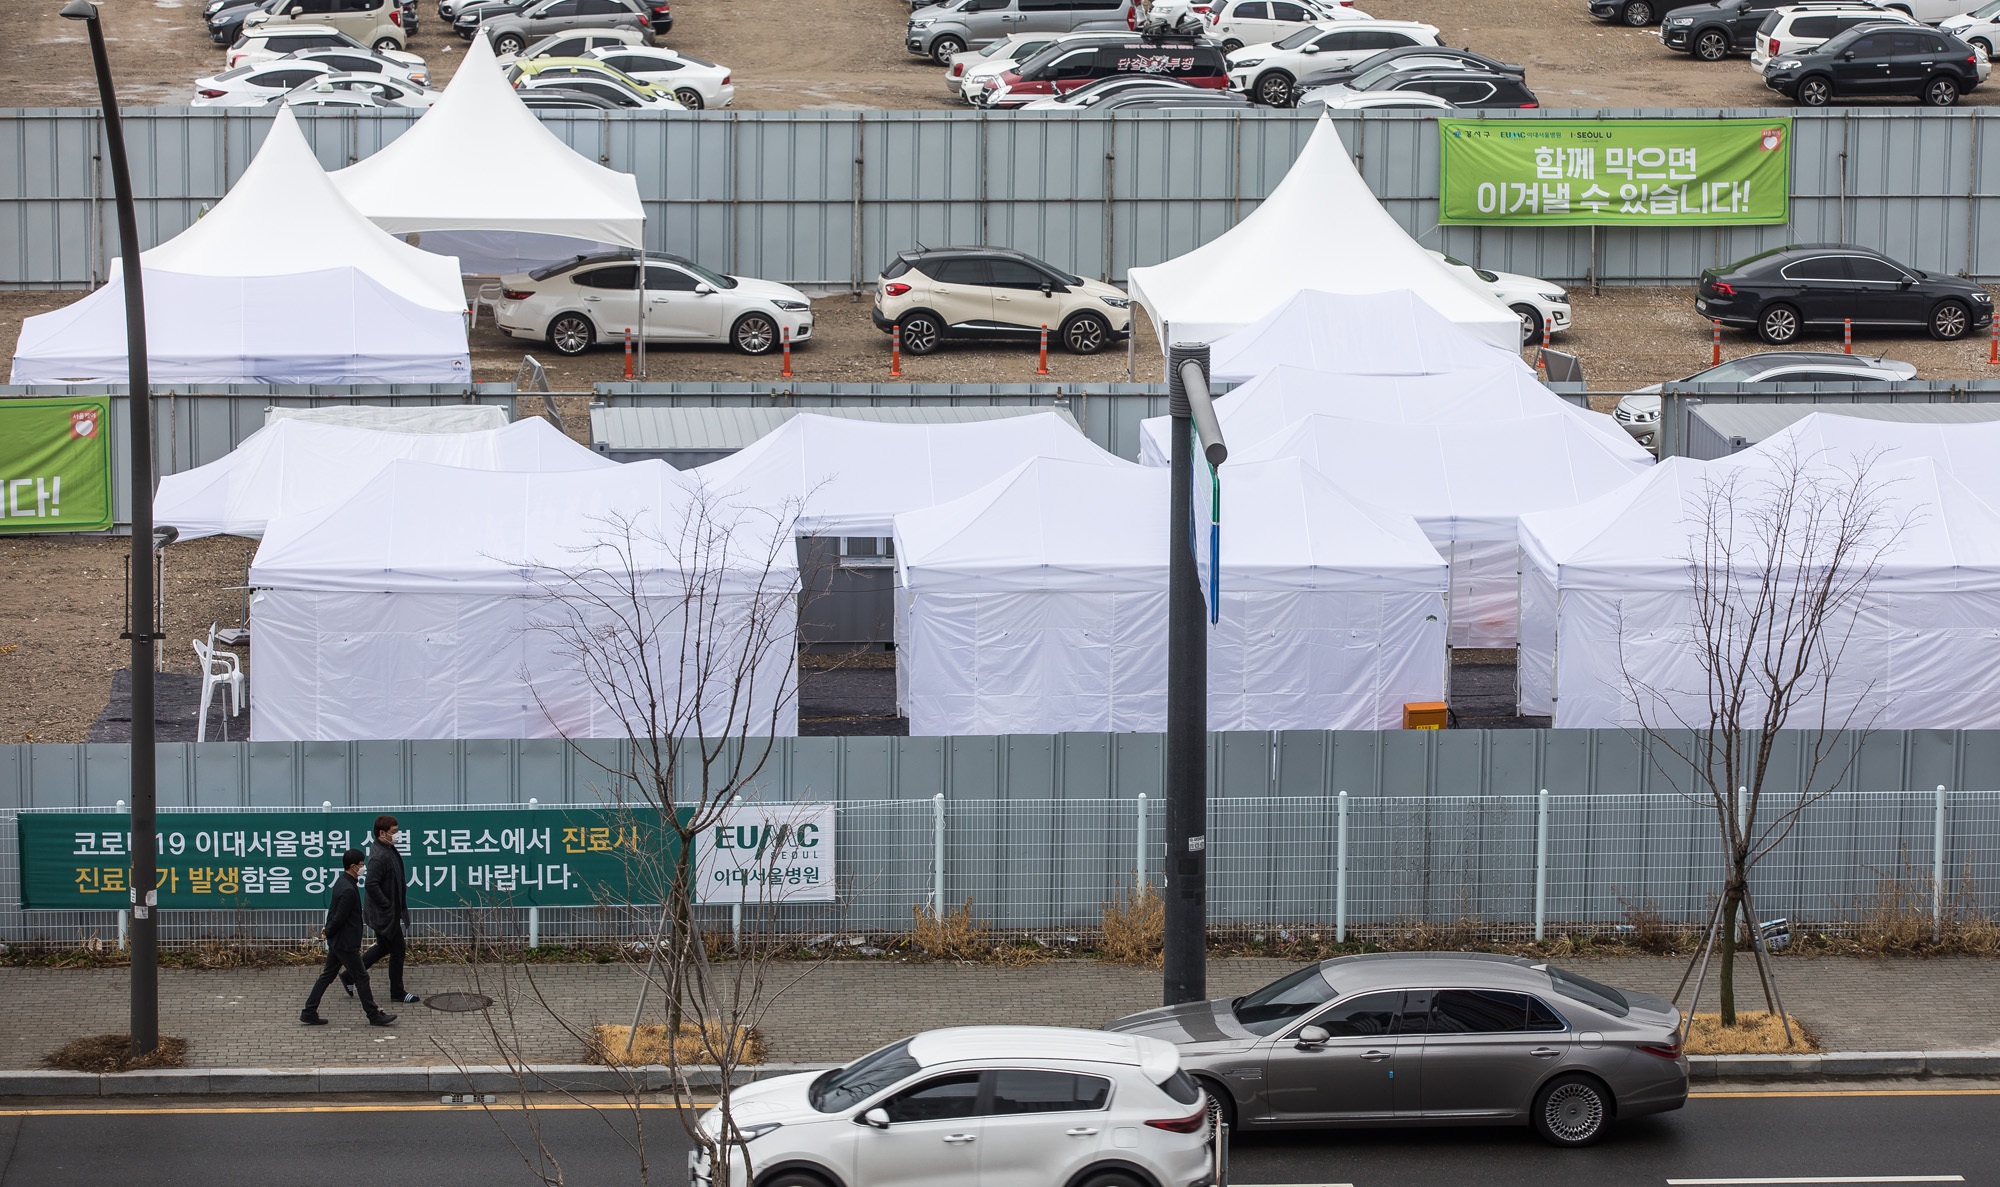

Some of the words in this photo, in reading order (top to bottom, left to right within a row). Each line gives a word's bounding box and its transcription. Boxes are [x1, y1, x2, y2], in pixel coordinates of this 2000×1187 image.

[1534, 146, 1595, 180] 함께
[1605, 146, 1697, 181] 막으면
[1477, 182, 1571, 214] 이겨낼
[1580, 183, 1610, 214] 수
[1619, 180, 1751, 214] 있습니다!
[0, 476, 61, 519] 다!
[73, 831, 186, 856] 코로19
[195, 830, 351, 858] 이대서울병원
[422, 827, 551, 856] 진료소에서
[561, 826, 638, 854] 진료시
[715, 823, 819, 860] EUMC
[770, 850, 819, 860] SEOUL
[75, 866, 180, 894] 진료가
[188, 866, 293, 895] 발생함을
[467, 862, 578, 891] 바랍니다.
[714, 866, 819, 887] 이대서울병원
